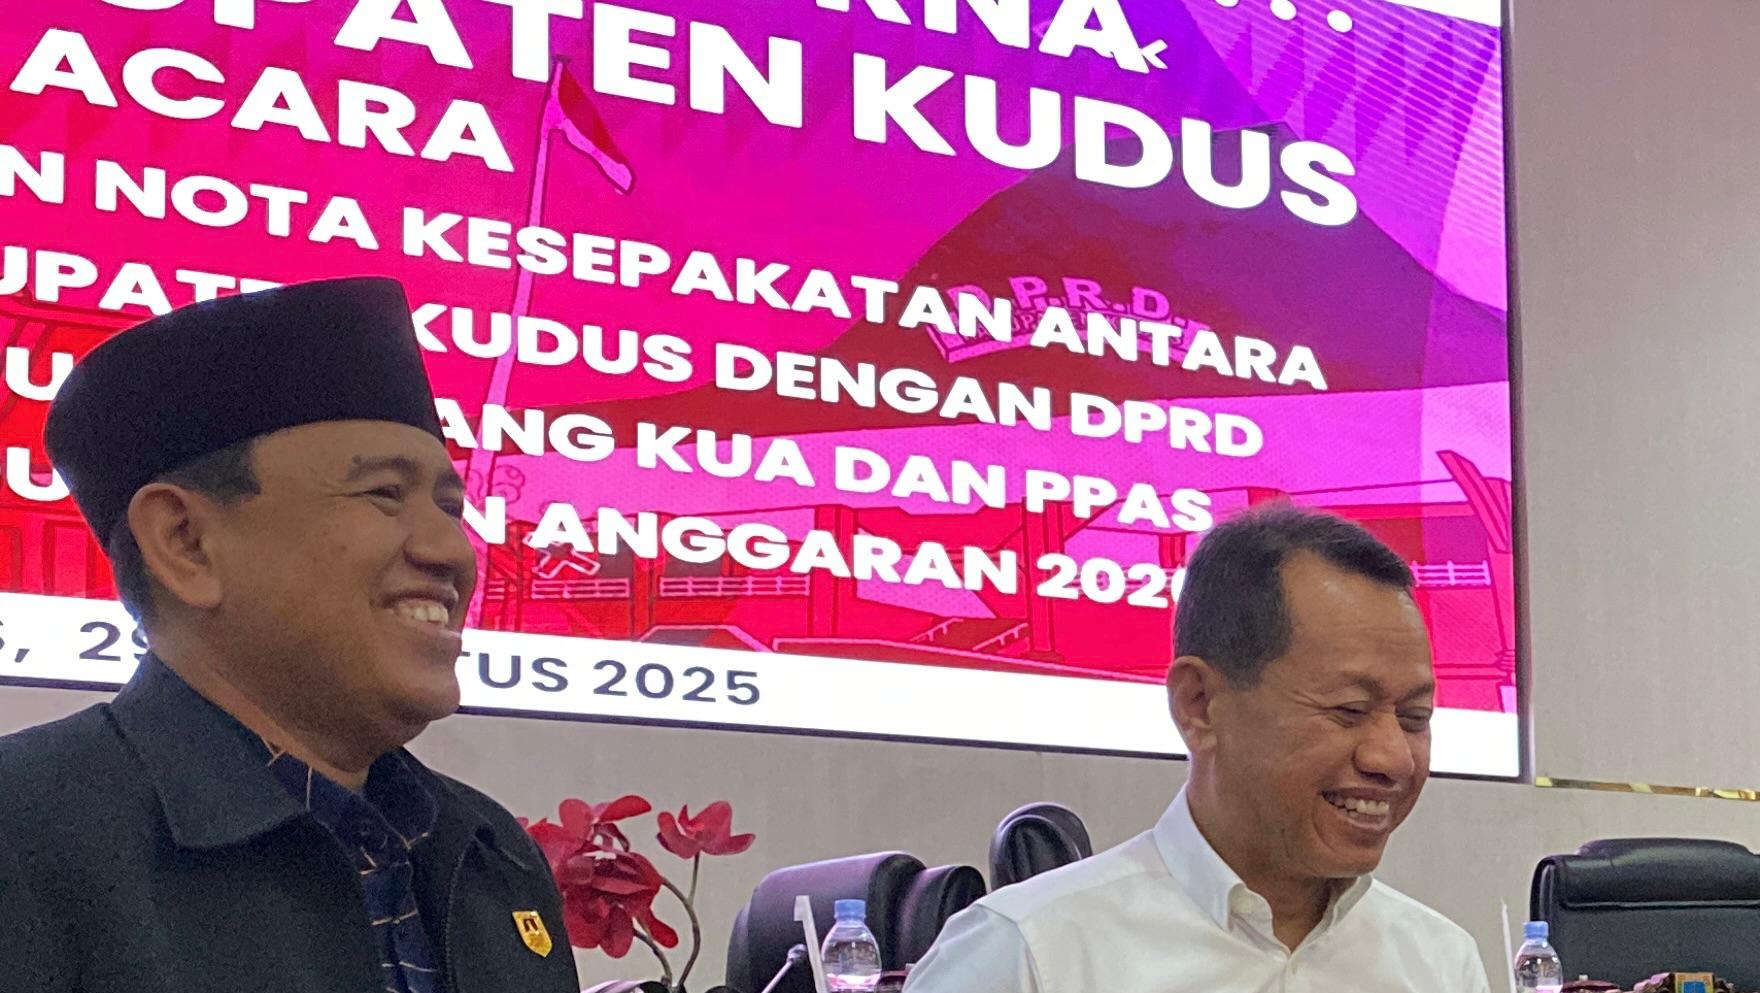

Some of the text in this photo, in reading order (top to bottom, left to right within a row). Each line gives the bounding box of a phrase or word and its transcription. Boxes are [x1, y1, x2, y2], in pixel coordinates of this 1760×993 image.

[10, 28, 514, 173] ACARA
[104, 0, 1358, 227] ATEN KUDUS
[95, 159, 379, 251] NOTA
[402, 206, 1013, 343] KESEPAKATAN
[1029, 305, 1328, 391] ANTARA
[715, 342, 1052, 431] DENGAN
[1070, 391, 1264, 457] DPRD
[636, 421, 816, 487] KUA
[834, 445, 1006, 509] DAN
[1025, 469, 1214, 533] PPAS
[527, 502, 1018, 595] ANGGARAN
[1036, 552, 1187, 609] 202
[461, 651, 569, 693] US
[593, 659, 762, 706] 2025
